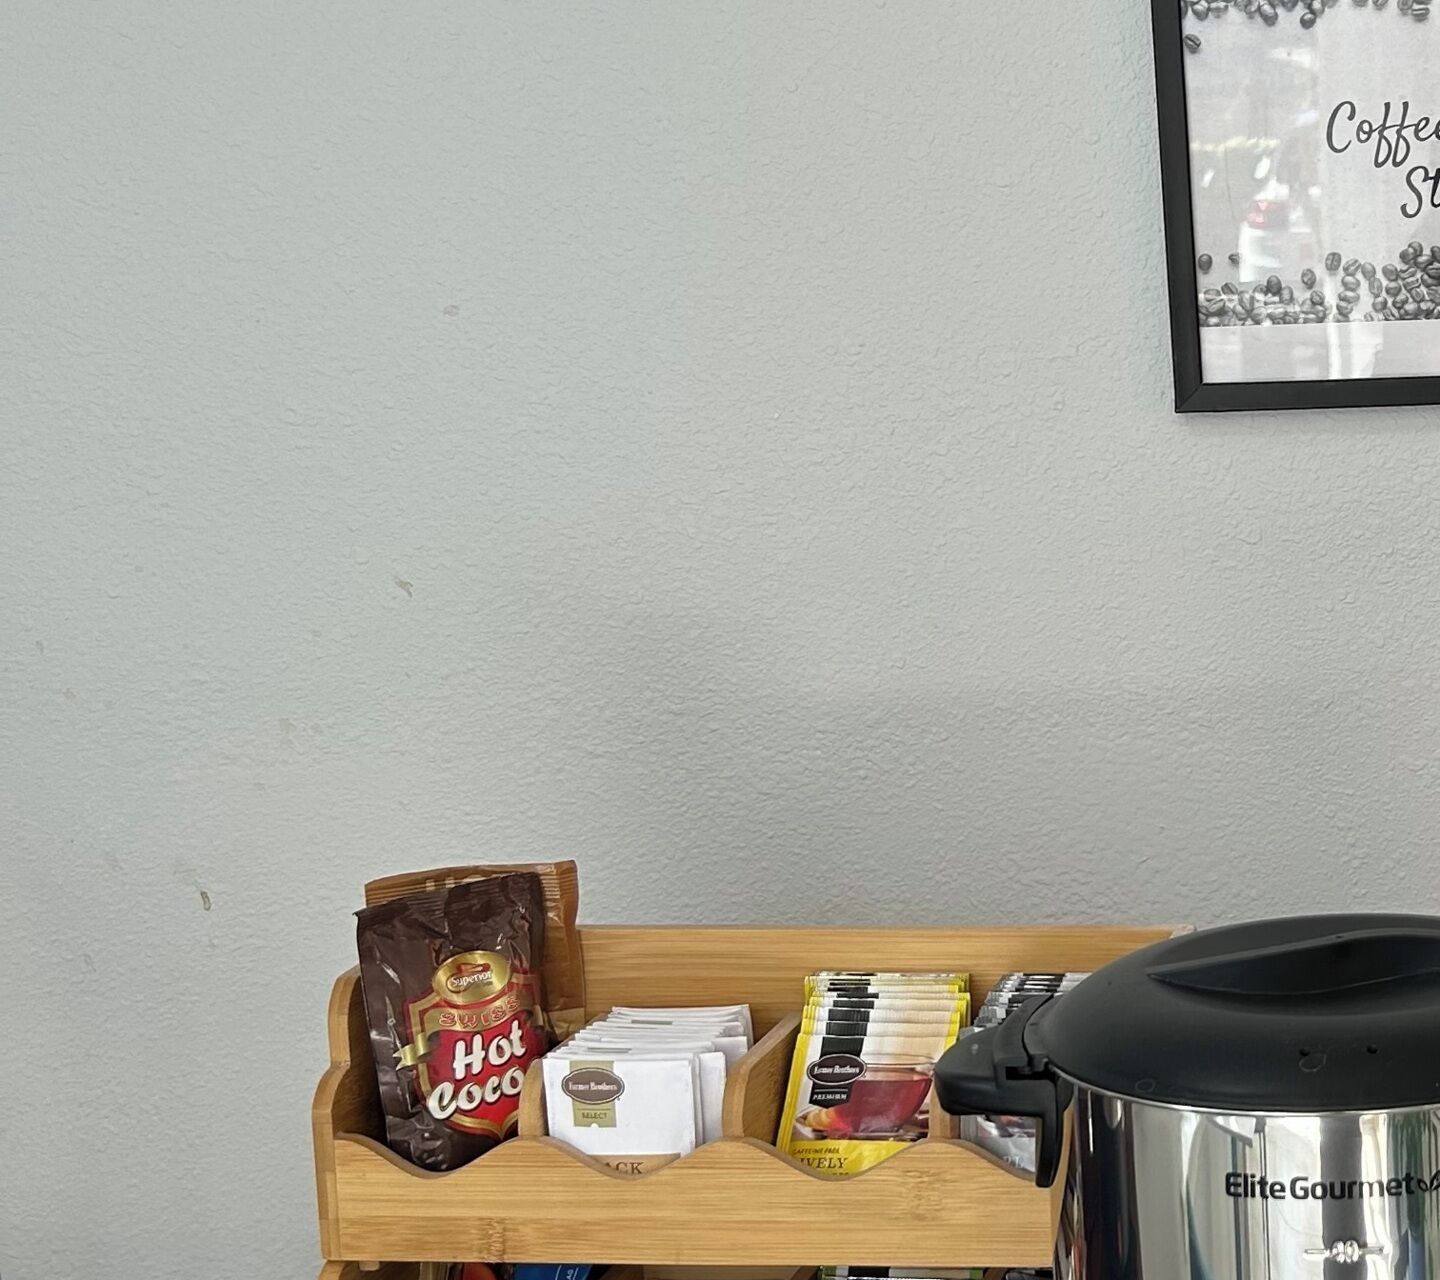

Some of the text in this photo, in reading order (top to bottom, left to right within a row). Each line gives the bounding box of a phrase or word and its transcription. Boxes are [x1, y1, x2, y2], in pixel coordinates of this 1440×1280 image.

[449, 970, 493, 988] Superior
[438, 996, 521, 1027] SWISS
[452, 1019, 527, 1081] Hot
[427, 1067, 525, 1121] Coco
[581, 1111, 608, 1120] SELECT
[799, 1157, 848, 1170] IVELY
[1225, 1171, 1415, 1201] Elite Gourmet
